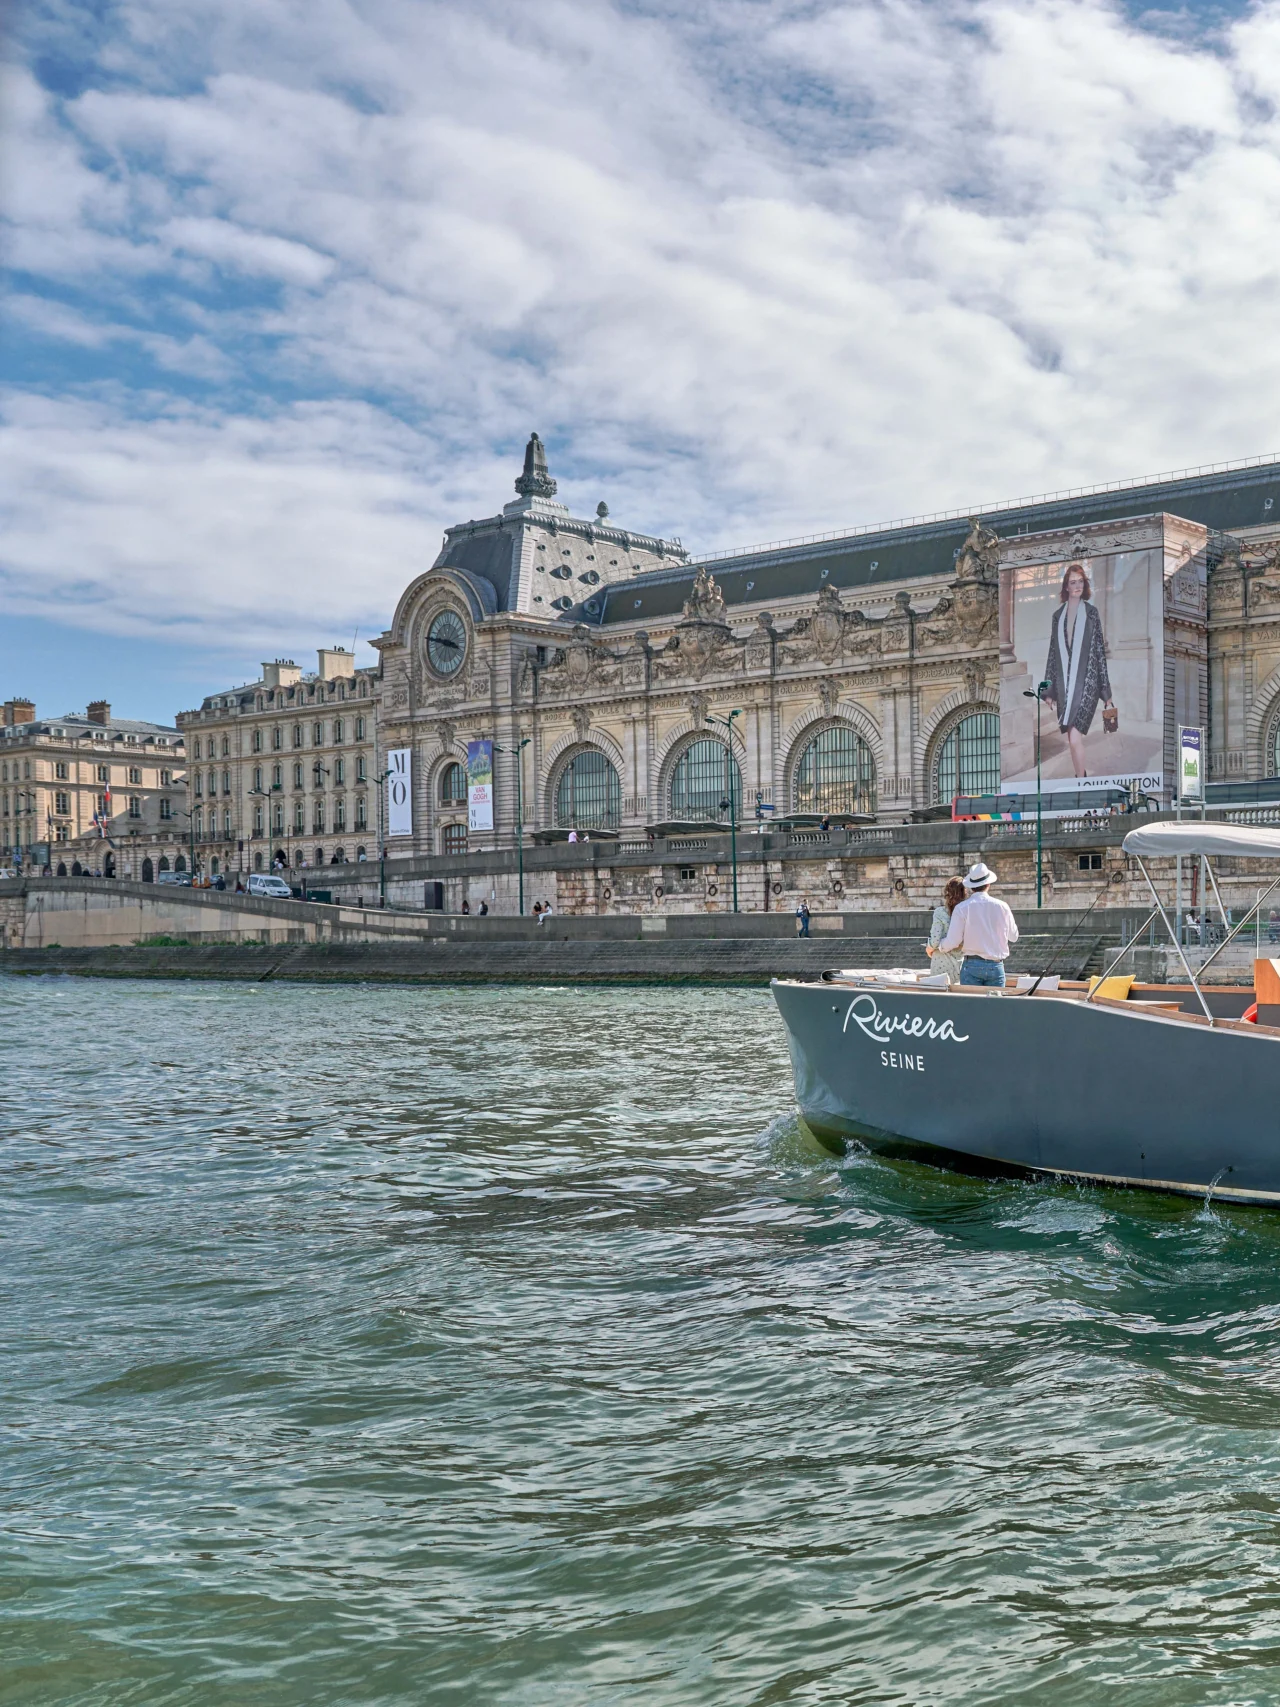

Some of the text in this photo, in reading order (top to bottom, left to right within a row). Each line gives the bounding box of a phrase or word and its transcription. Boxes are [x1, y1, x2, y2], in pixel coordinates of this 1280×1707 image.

[917, 667, 960, 679] BORDEAUX
[780, 676, 879, 695] ORLEANS BOURGES
[393, 753, 405, 774] M
[842, 993, 970, 1042] Riviera
[880, 1050, 925, 1072] SEINE
